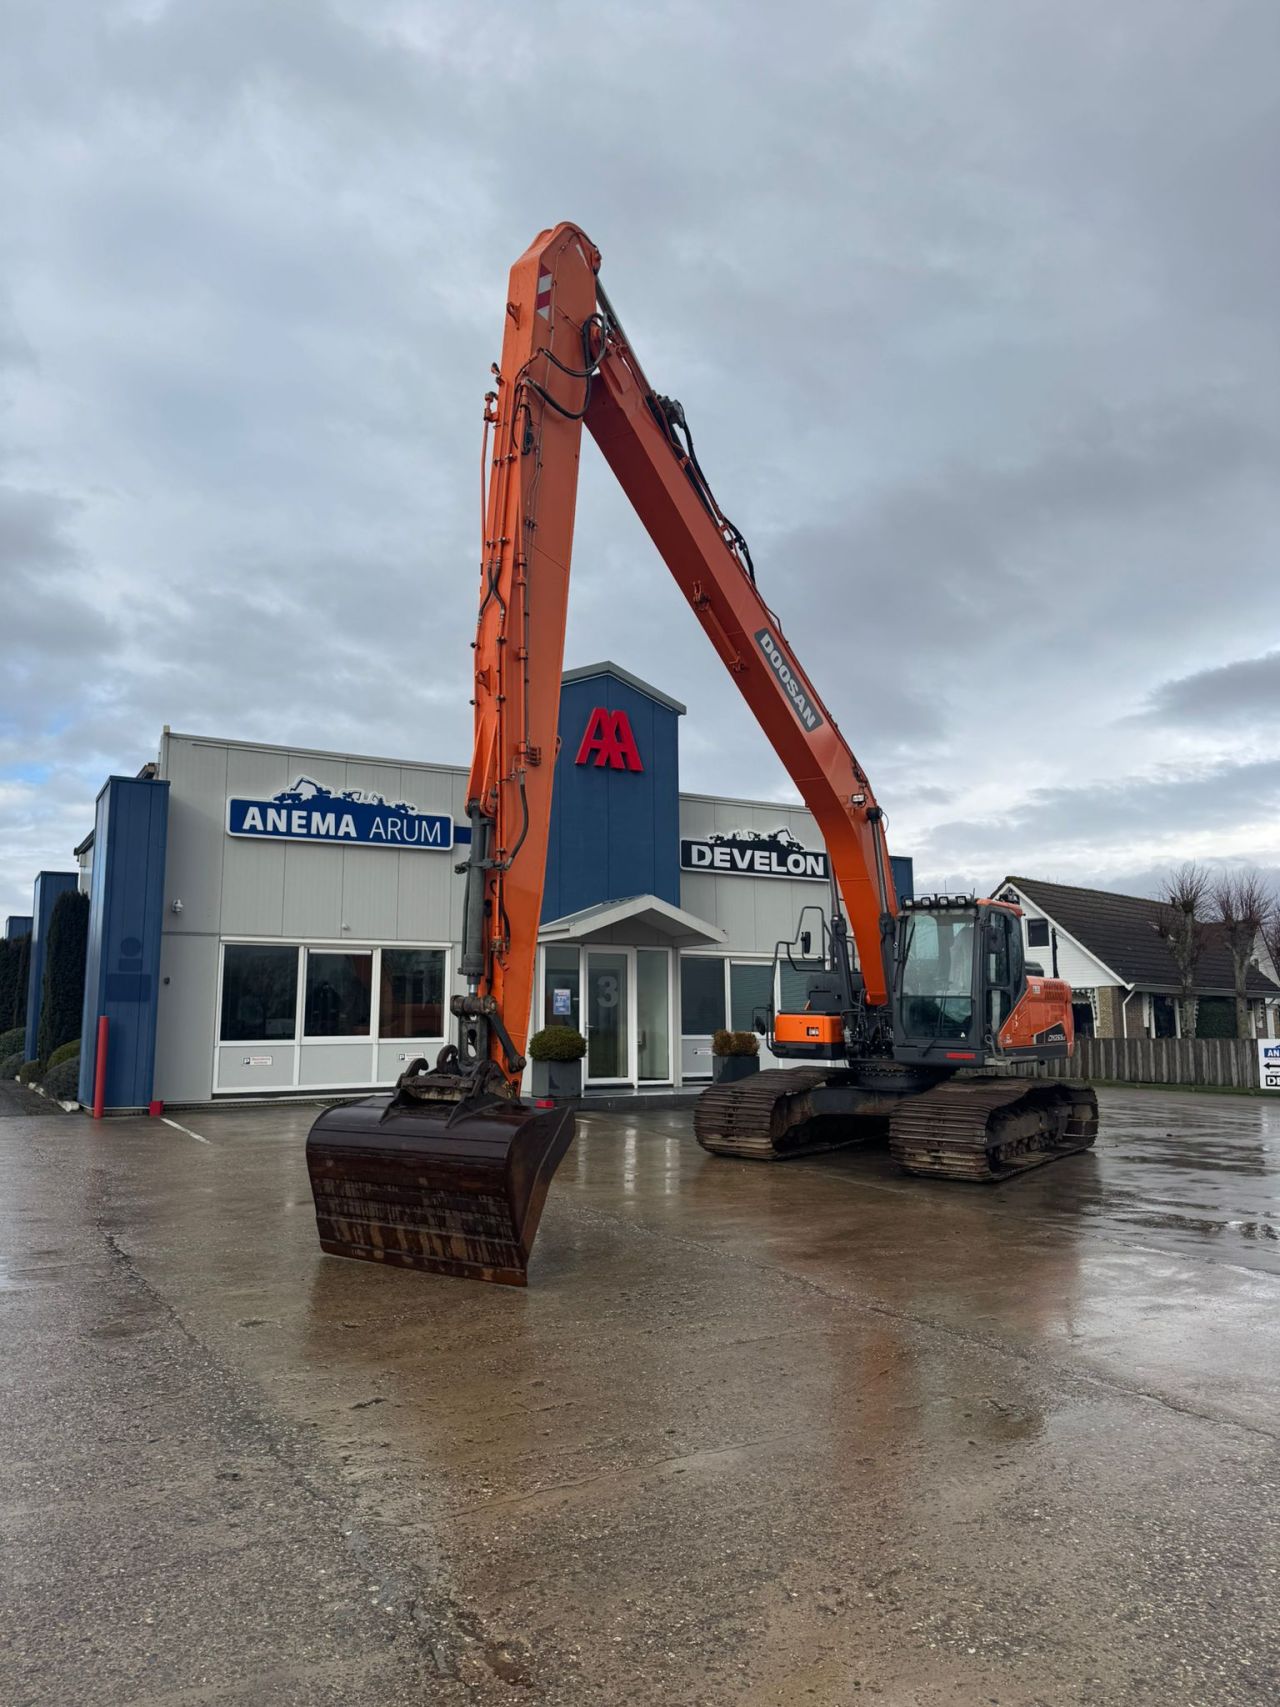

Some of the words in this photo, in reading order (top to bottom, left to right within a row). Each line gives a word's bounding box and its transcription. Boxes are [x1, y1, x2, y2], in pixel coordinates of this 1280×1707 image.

[760, 633, 816, 727] DOOSAN
[242, 806, 357, 837] ANEMA
[369, 816, 441, 843] ARUM
[691, 844, 824, 876] DEVELON
[597, 976, 618, 1007] 3
